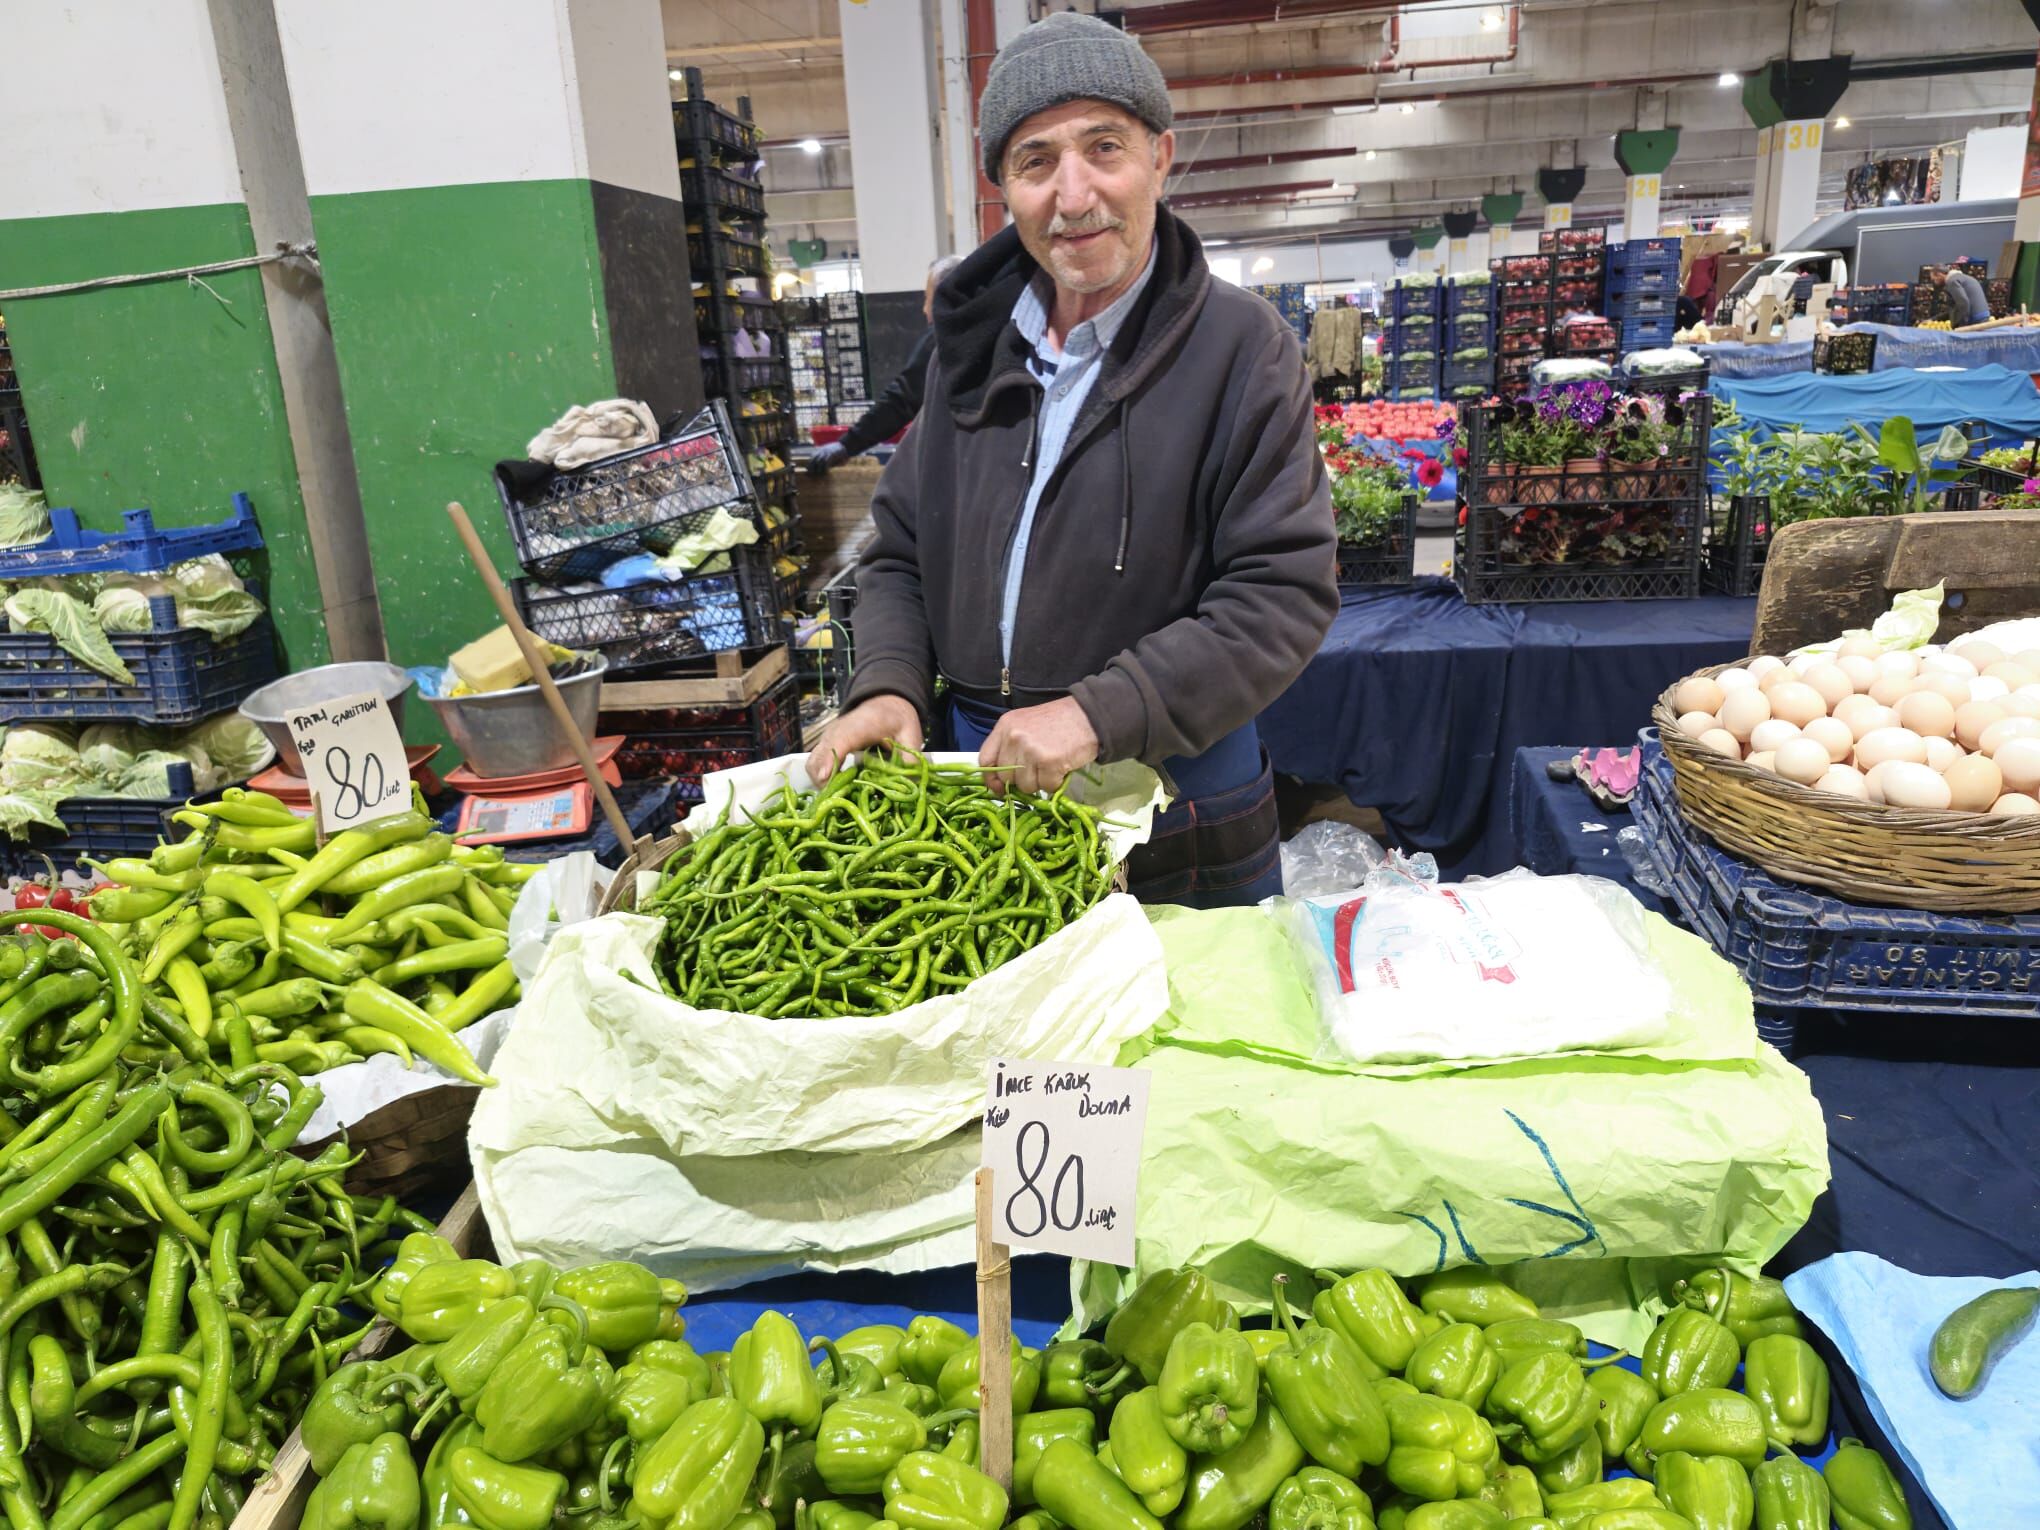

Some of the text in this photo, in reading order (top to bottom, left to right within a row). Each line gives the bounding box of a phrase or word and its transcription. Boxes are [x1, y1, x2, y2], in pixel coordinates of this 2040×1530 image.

[1788, 124, 1821, 149] 30
[1635, 178, 1658, 198] 29
[326, 746, 384, 819] 80
[1043, 1072, 1091, 1096] KABUK
[1079, 1093, 1131, 1118] DOLMA
[1005, 1120, 1084, 1238] 80
